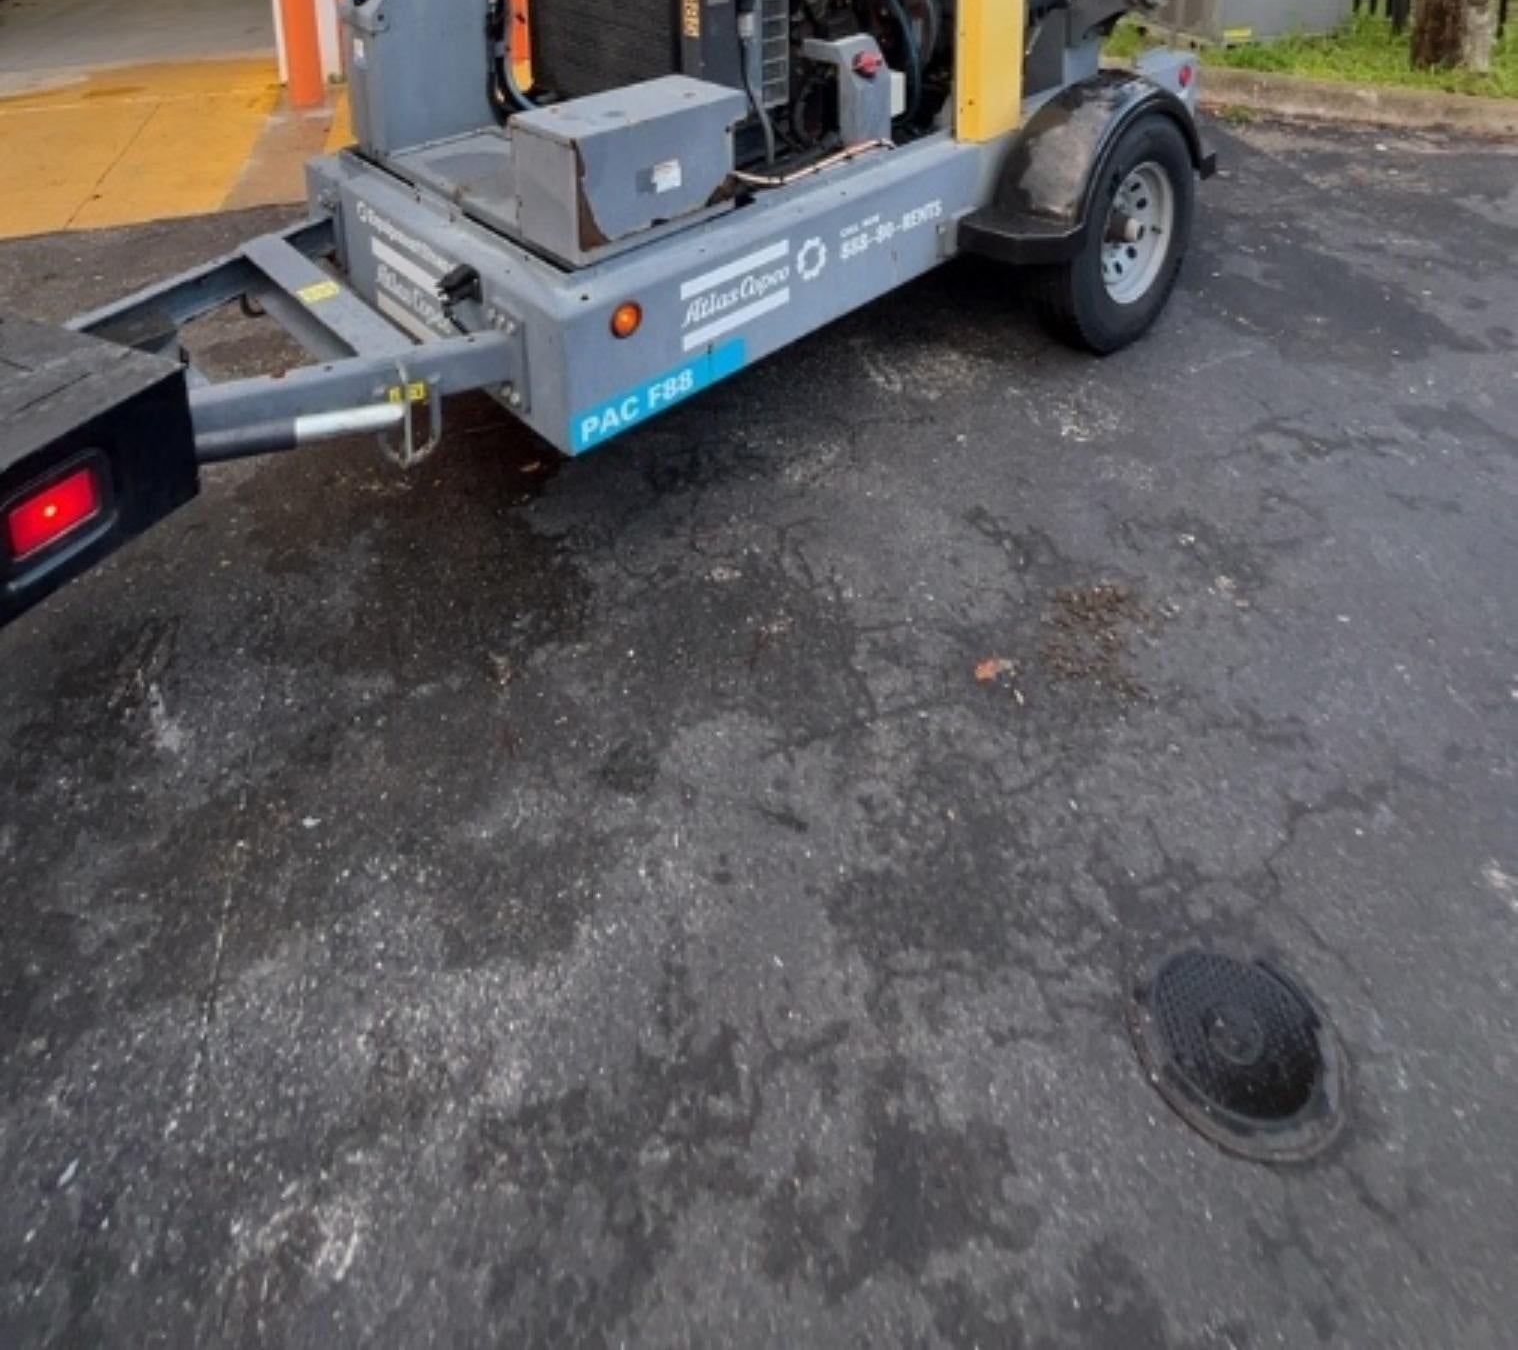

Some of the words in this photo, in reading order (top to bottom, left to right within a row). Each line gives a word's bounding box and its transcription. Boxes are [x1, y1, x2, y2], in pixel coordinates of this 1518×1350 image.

[681, 288, 738, 329] Atlas
[740, 265, 790, 300] Copco
[580, 396, 640, 442] PAC
[647, 368, 694, 409] F88
